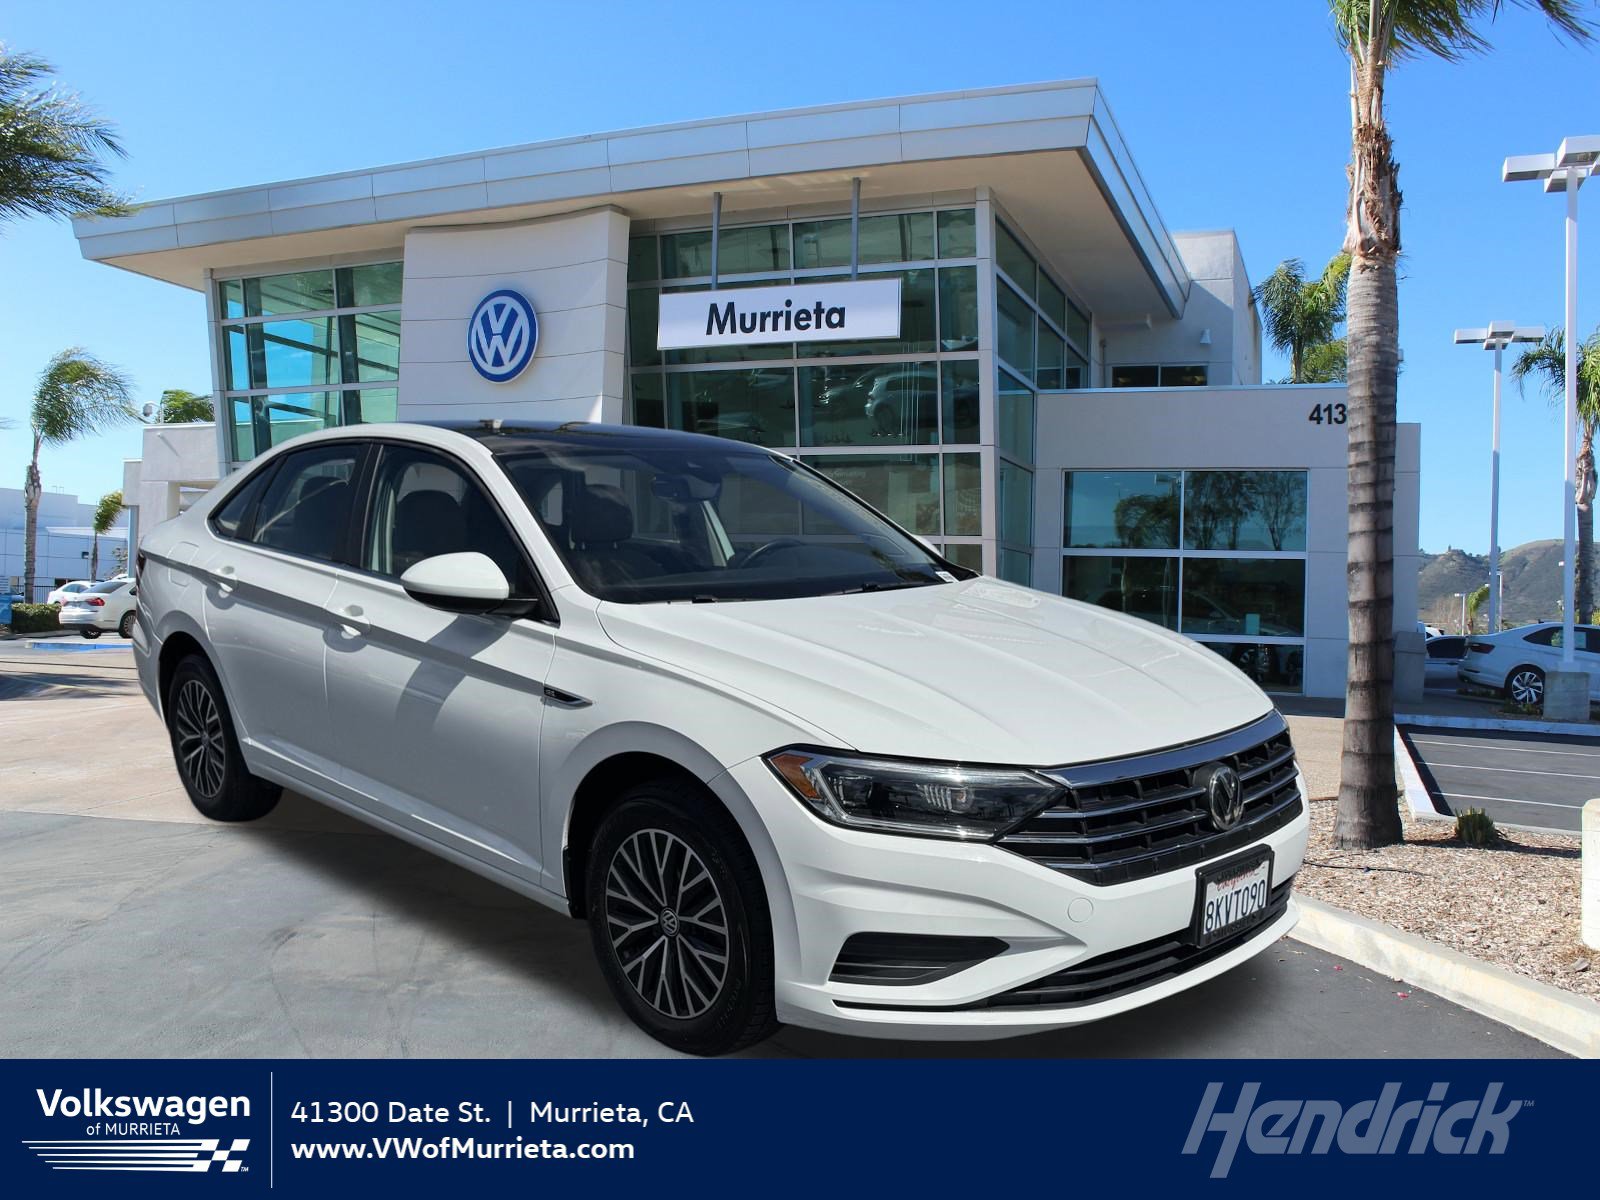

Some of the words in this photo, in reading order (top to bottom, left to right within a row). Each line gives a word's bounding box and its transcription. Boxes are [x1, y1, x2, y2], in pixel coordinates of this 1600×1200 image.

[706, 299, 846, 336] Murrieta
[1308, 403, 1347, 425] 413
[1205, 879, 1266, 932] 8KVT090
